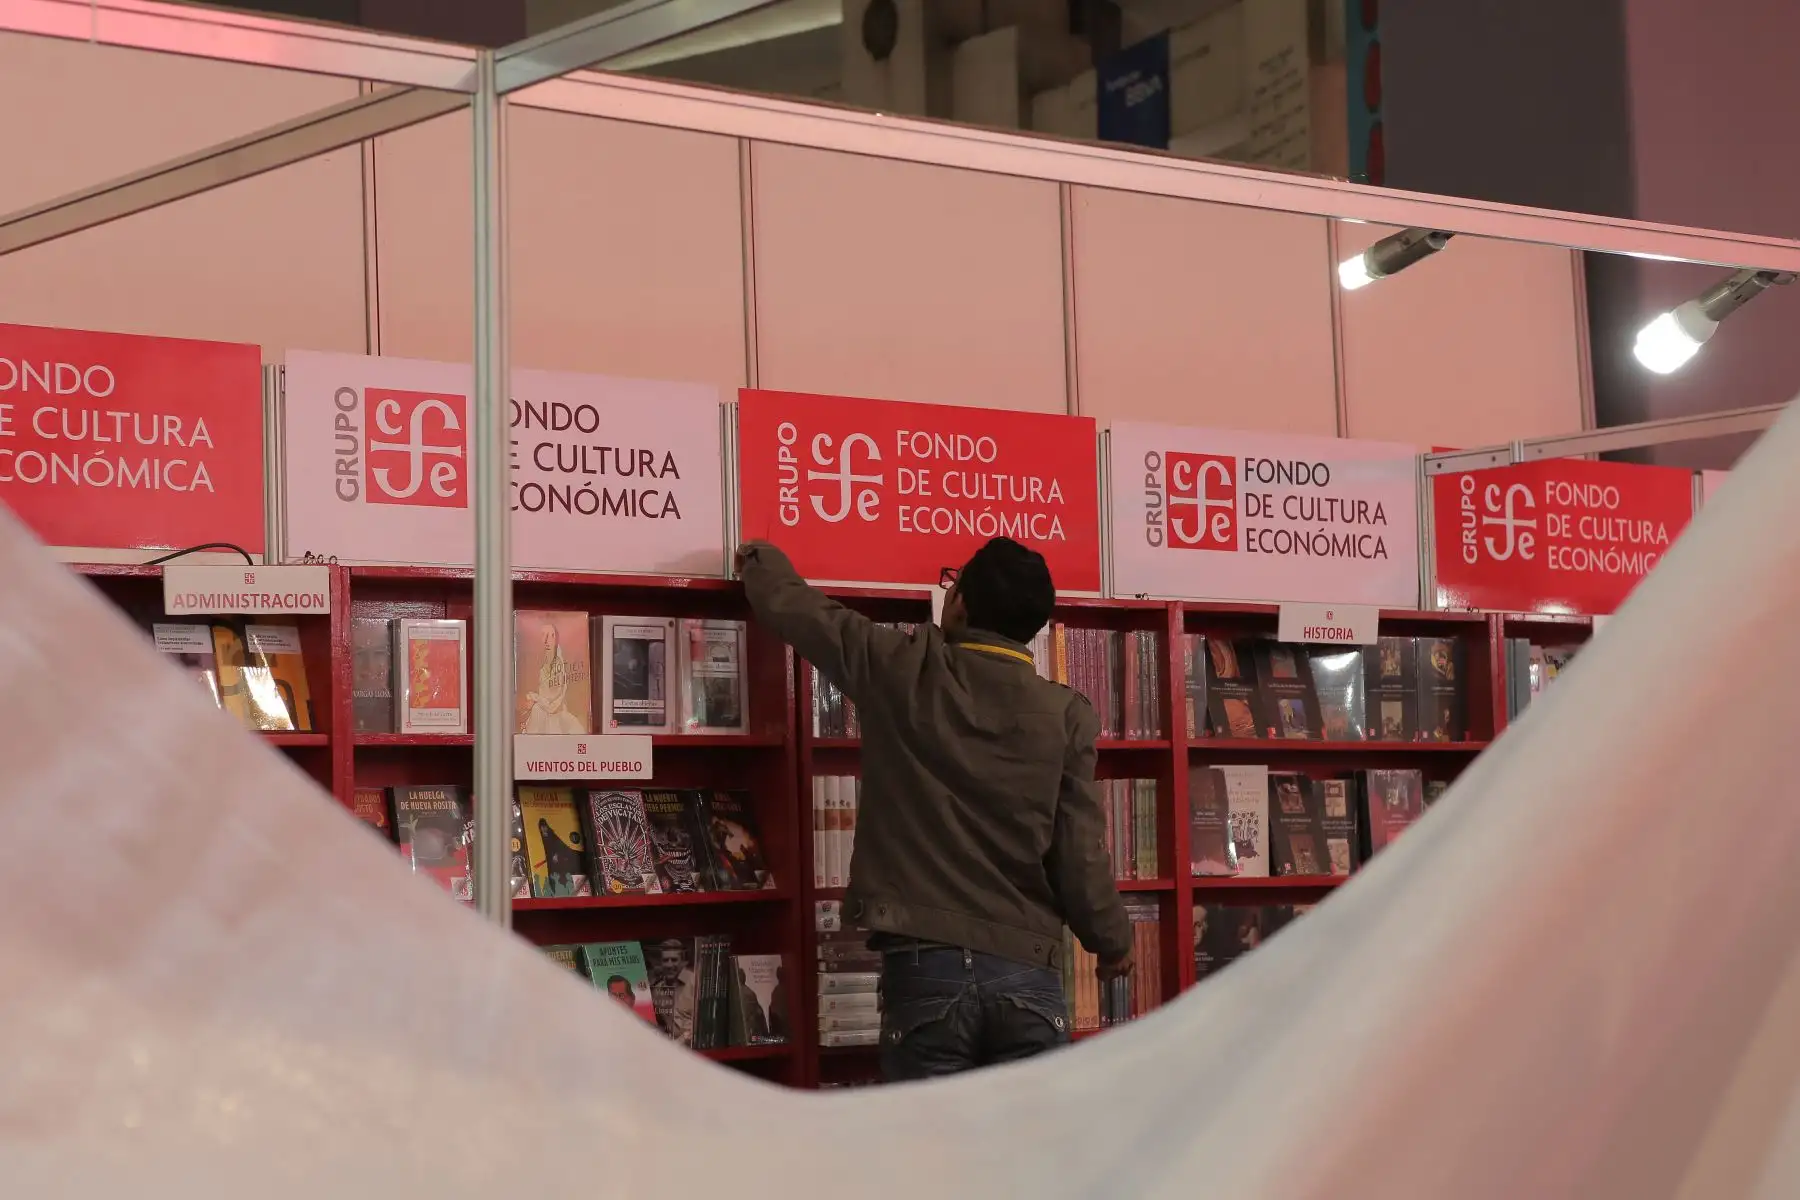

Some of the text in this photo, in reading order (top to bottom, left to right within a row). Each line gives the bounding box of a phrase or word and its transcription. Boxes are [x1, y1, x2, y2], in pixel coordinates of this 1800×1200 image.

[32, 406, 214, 449] CULTURA
[334, 386, 360, 502] GRUPO
[533, 442, 680, 479] CULTURA
[896, 430, 998, 463] FONDO
[777, 421, 800, 527] GRUPO
[897, 467, 1066, 505] DE CULTURA
[1244, 457, 1331, 488] FONDO
[1144, 450, 1163, 548] GRUPO
[1245, 492, 1388, 526] DE CULTURA
[1545, 480, 1620, 510] FONDO
[898, 504, 1067, 541] ECONÓMICA
[1460, 474, 1479, 565] GRUPO
[1546, 513, 1669, 545] DE CULTURA
[1246, 527, 1389, 560] ECONÓMICA
[1547, 545, 1665, 575] ECONÓMIC
[173, 593, 325, 609] ADMINISTRACION
[1303, 626, 1354, 640] HISTORIA
[527, 761, 642, 773] VIENTOS DEL PUEBLO
[400, 801, 410, 810] DE
[411, 801, 432, 810] NUEVA
[409, 790, 445, 800] LA HUELGA
